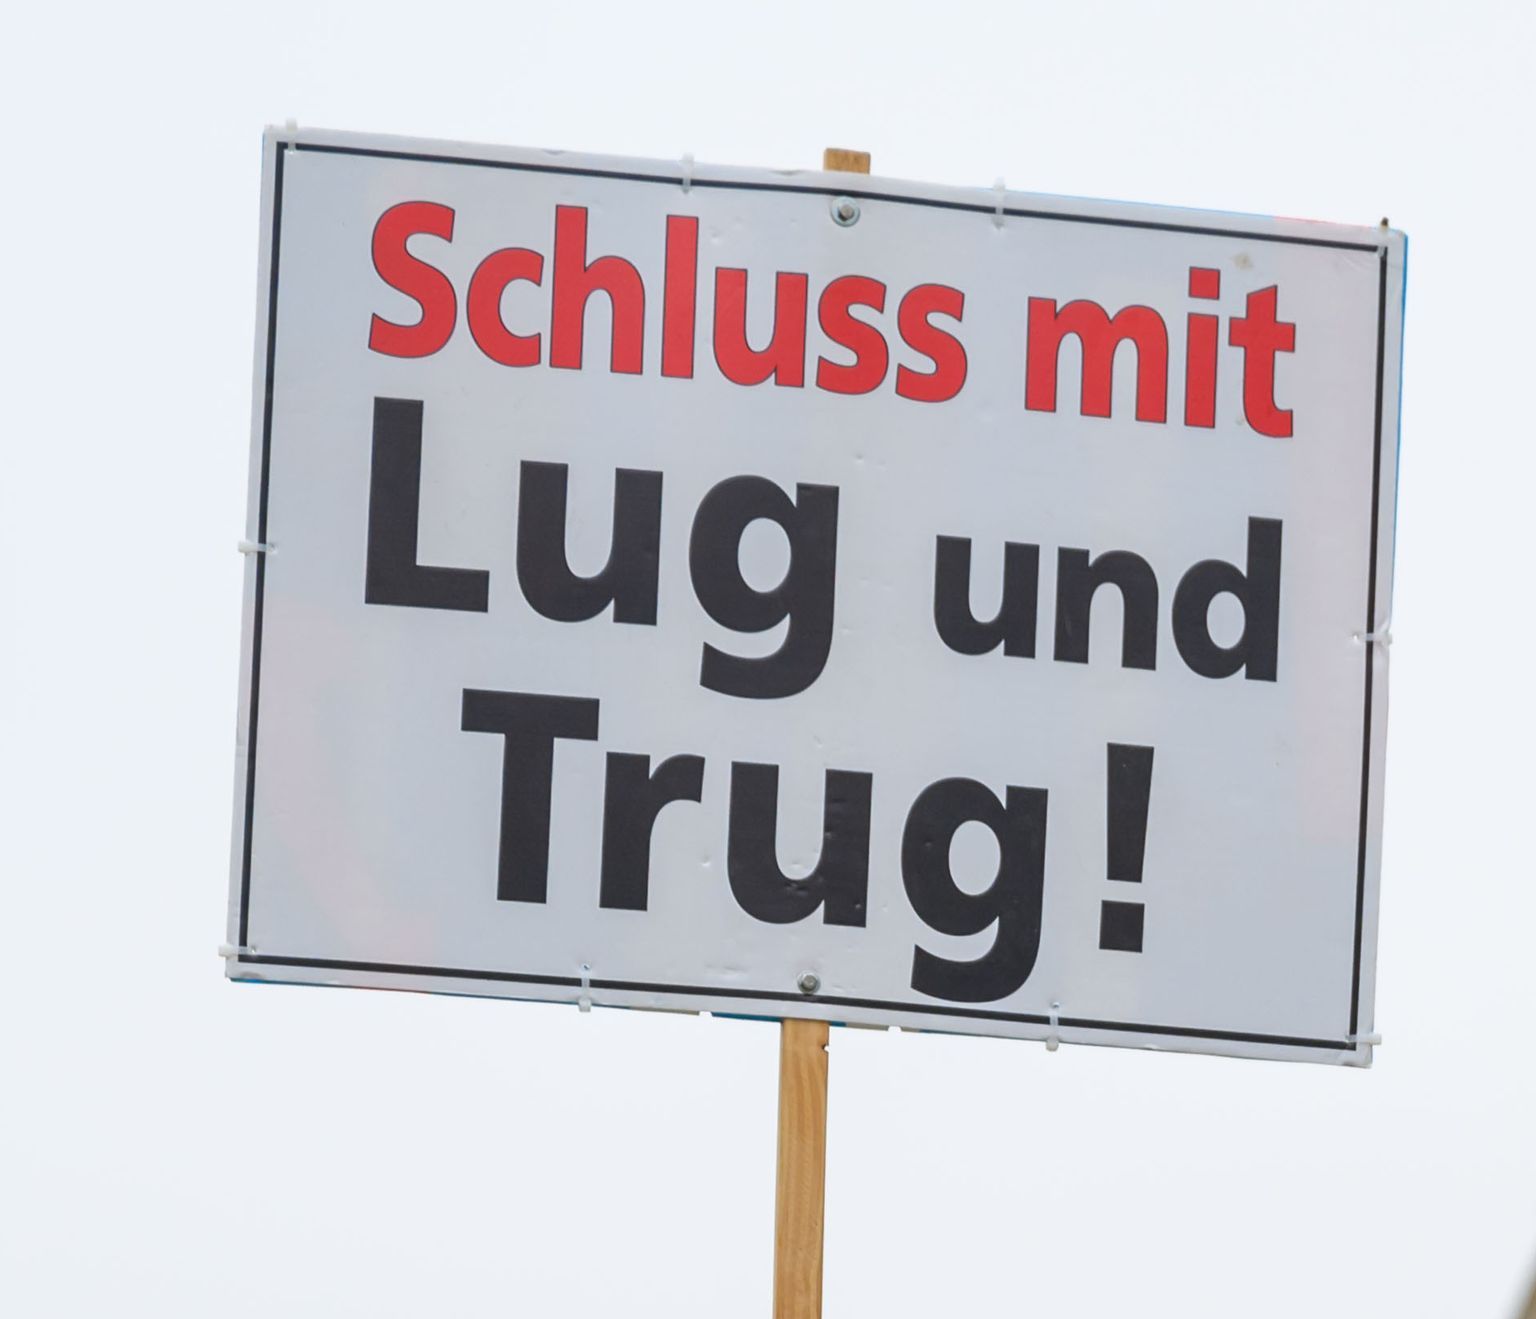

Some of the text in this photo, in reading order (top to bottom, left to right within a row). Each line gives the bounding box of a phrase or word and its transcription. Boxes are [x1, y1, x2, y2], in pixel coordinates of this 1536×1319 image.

[367, 200, 1296, 438] Schluss mit
[363, 396, 1284, 700] Lug und
[461, 687, 1155, 1003] Trug!
